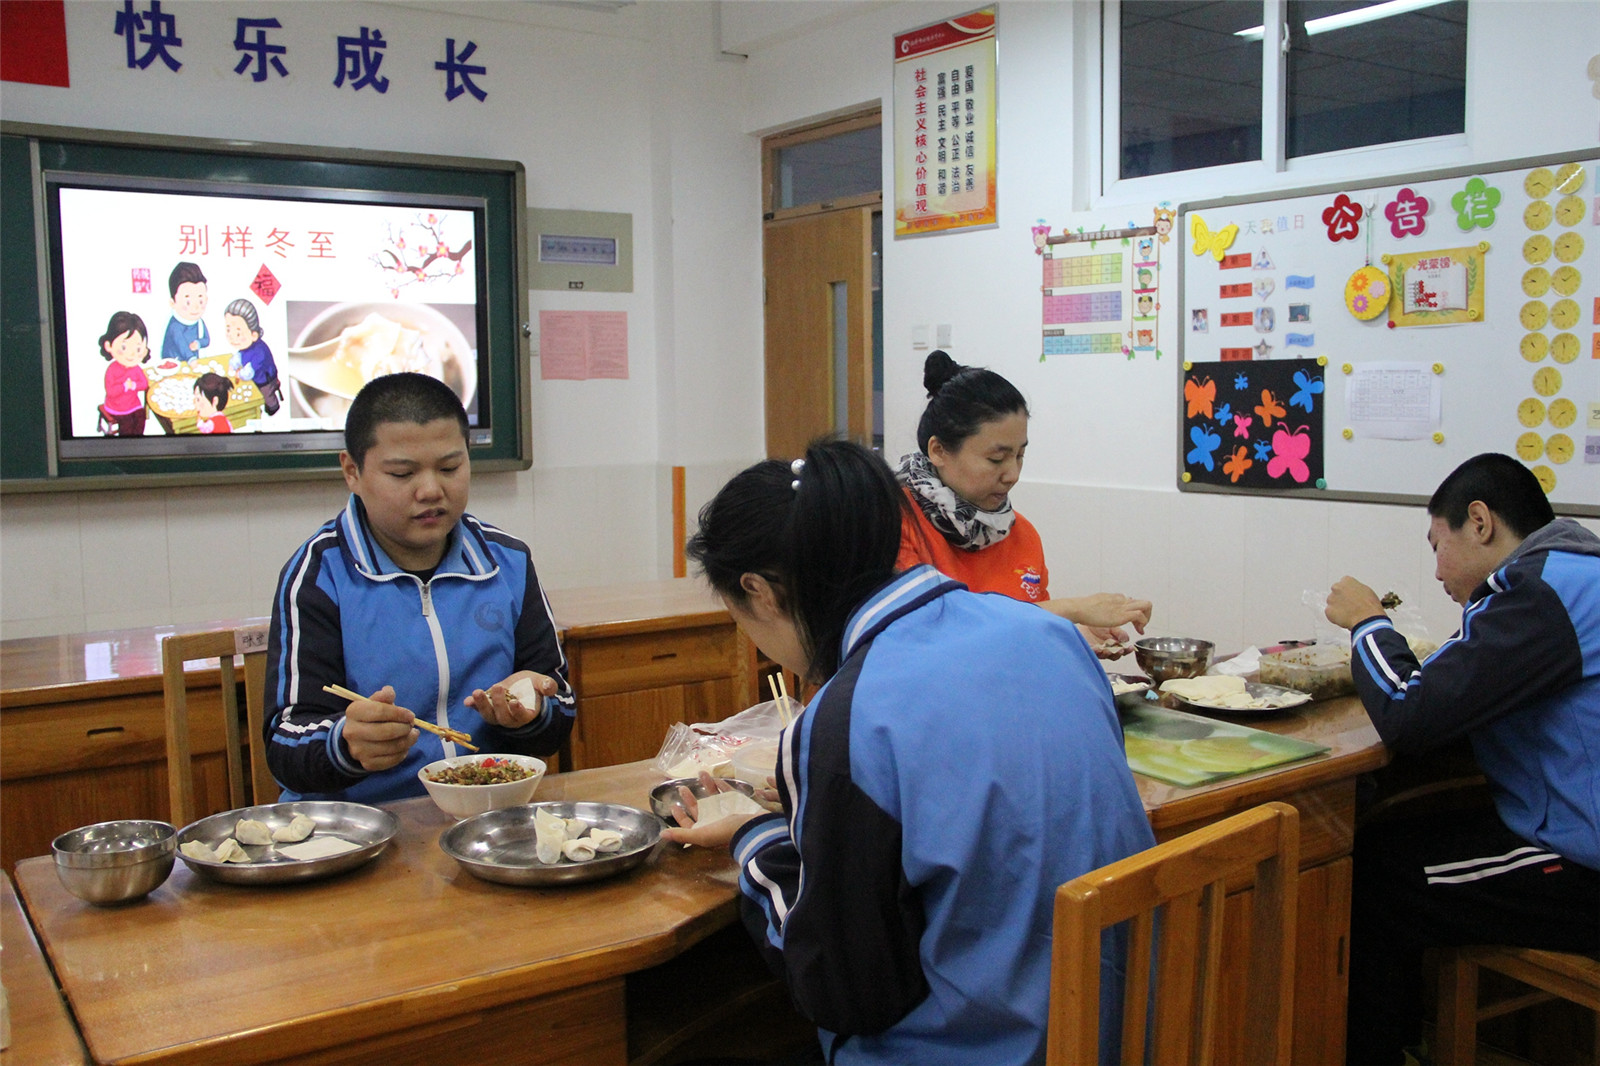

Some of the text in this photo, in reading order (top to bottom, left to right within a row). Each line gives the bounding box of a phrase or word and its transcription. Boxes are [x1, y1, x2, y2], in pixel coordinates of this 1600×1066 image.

[114, 0, 488, 102] 快乐成长
[915, 68, 928, 212] 社会主义核心价值观
[937, 72, 947, 196] 富强 民主 文明 和谐
[951, 69, 960, 194] 自由 平等 公正 法治
[965, 65, 974, 192] 爱国 敬业 诚信 友善
[179, 224, 336, 259] 别样冬至
[1330, 191, 1489, 235] 公告栏
[254, 274, 275, 298] 福
[1417, 257, 1451, 272] 光荣榜
